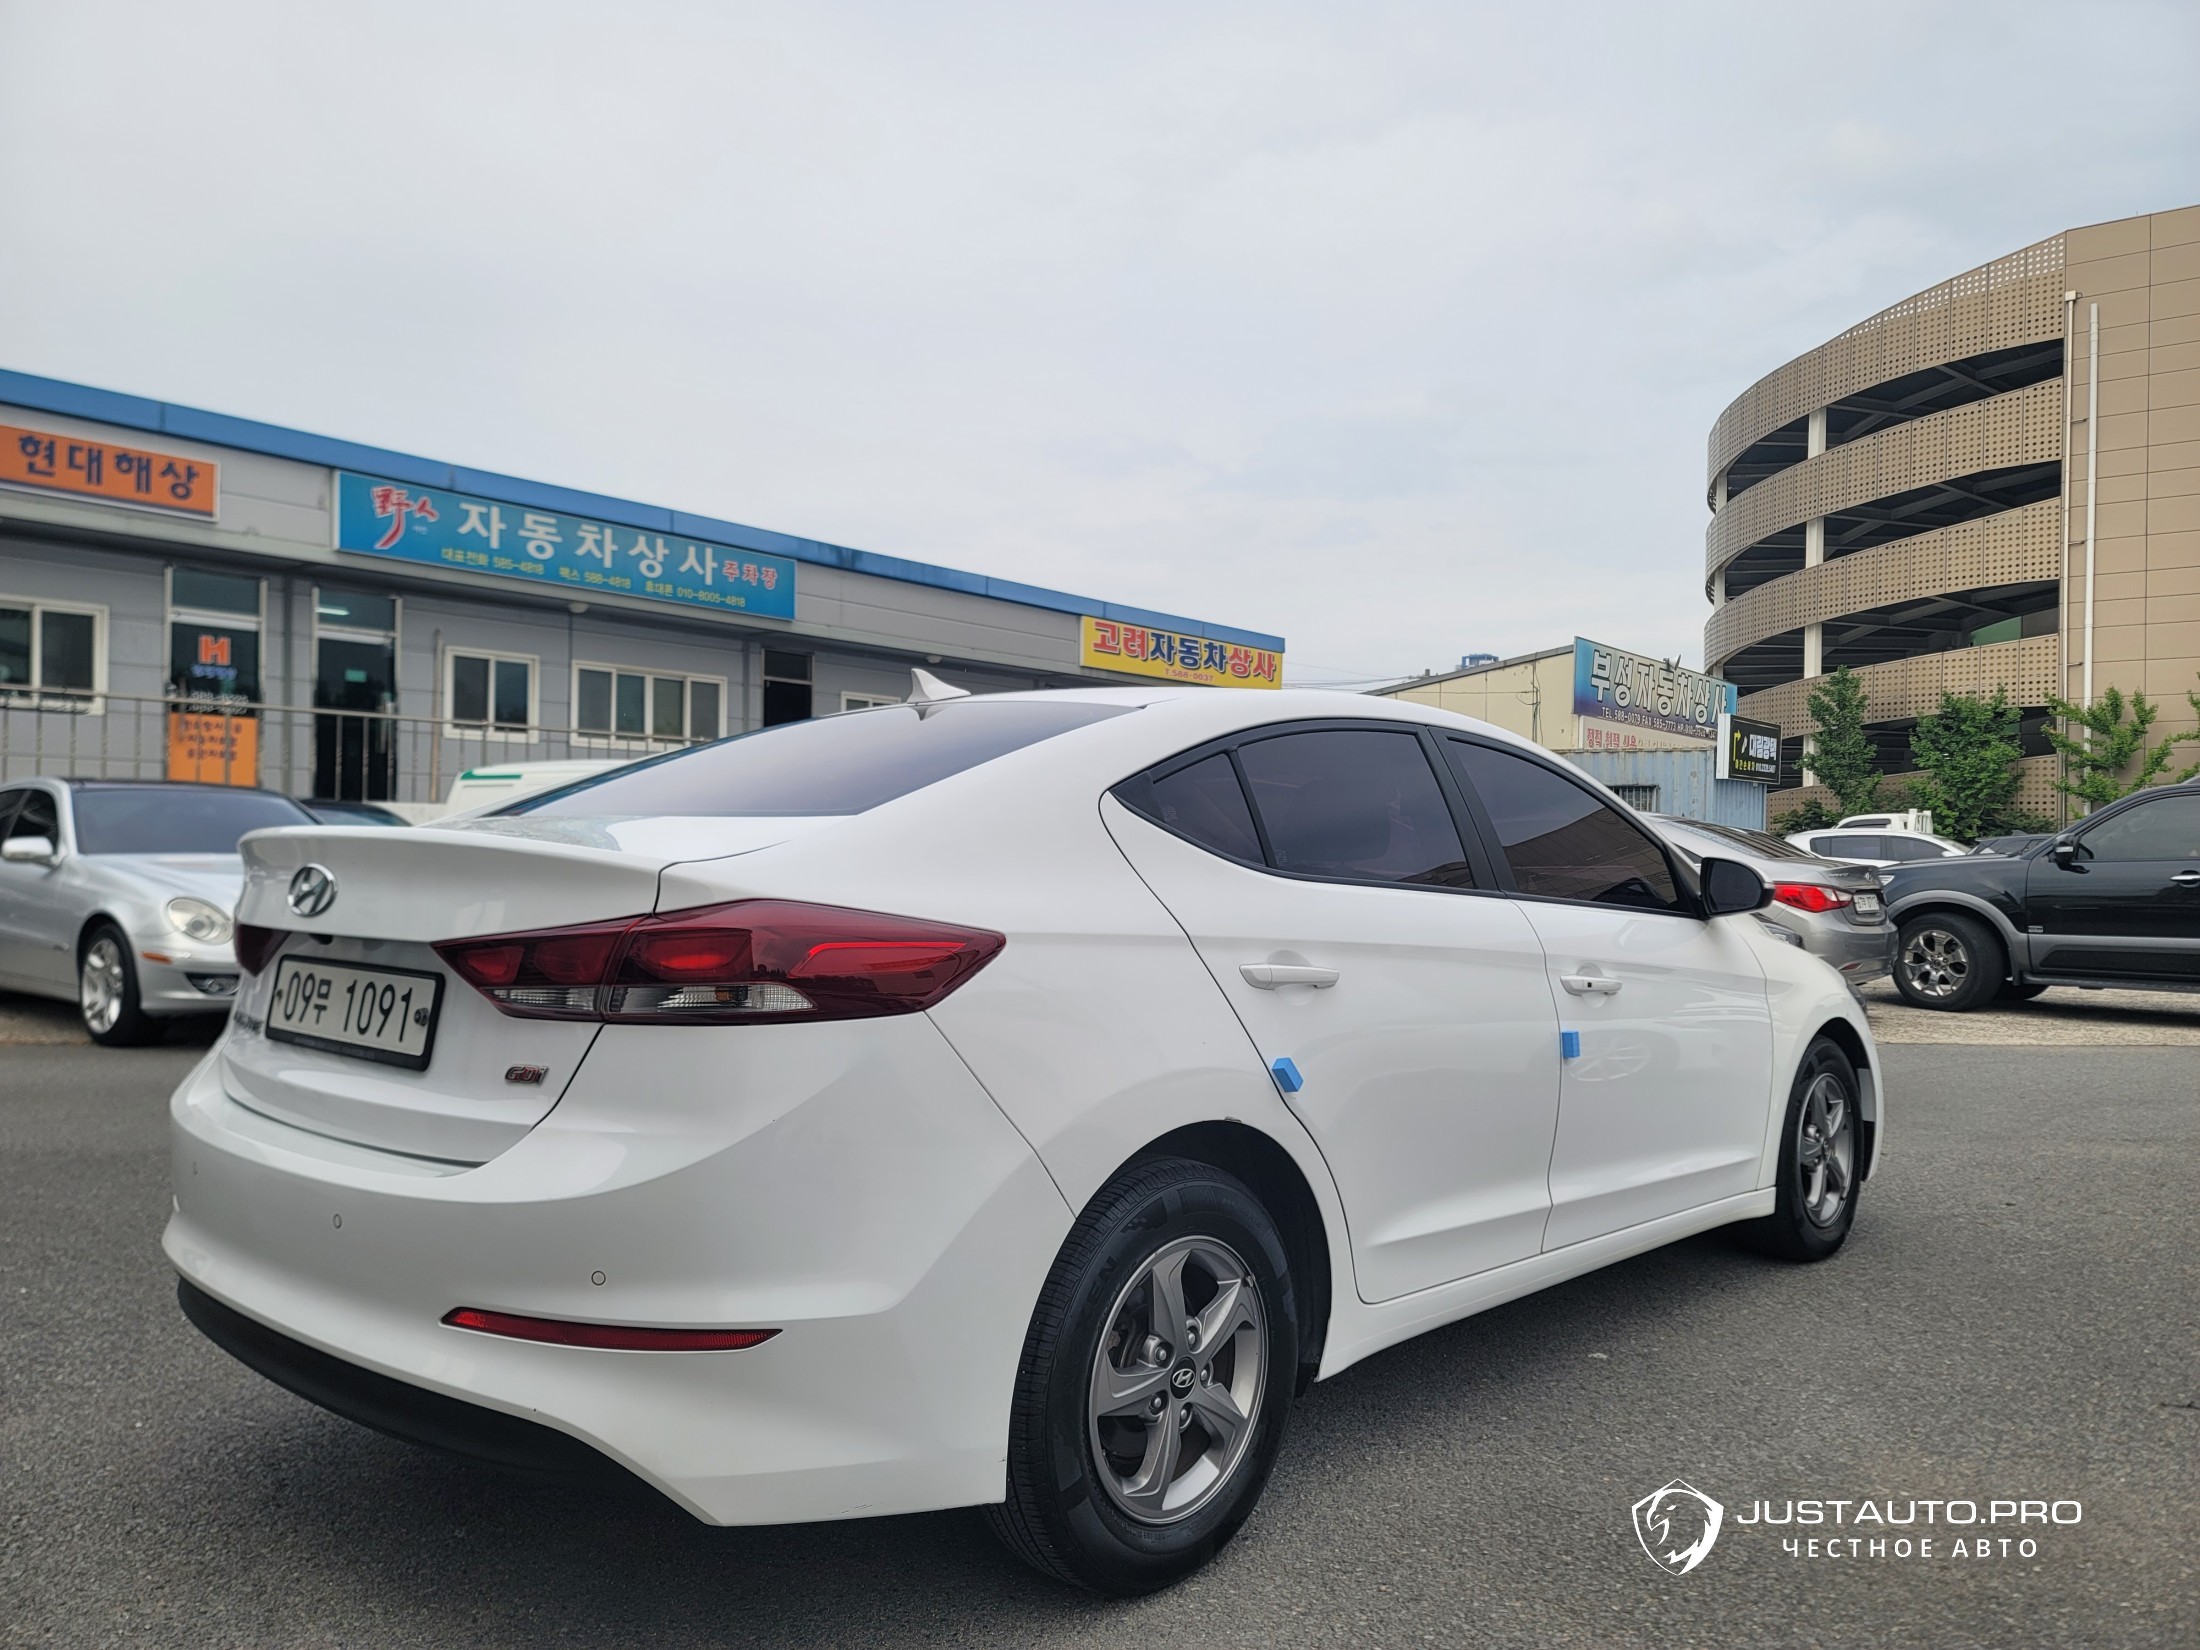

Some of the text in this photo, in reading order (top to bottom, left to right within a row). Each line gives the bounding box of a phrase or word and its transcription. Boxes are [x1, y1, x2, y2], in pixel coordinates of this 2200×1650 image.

[18, 434, 199, 501] 현대해상
[457, 502, 778, 590] 자동차상사 주차장
[677, 587, 746, 608] 010-8005-4818
[1092, 620, 1277, 682] 고려자동차상사
[1591, 649, 1727, 725] 부성자동차상사
[283, 971, 332, 1025] 09무
[343, 978, 414, 1043] 1091
